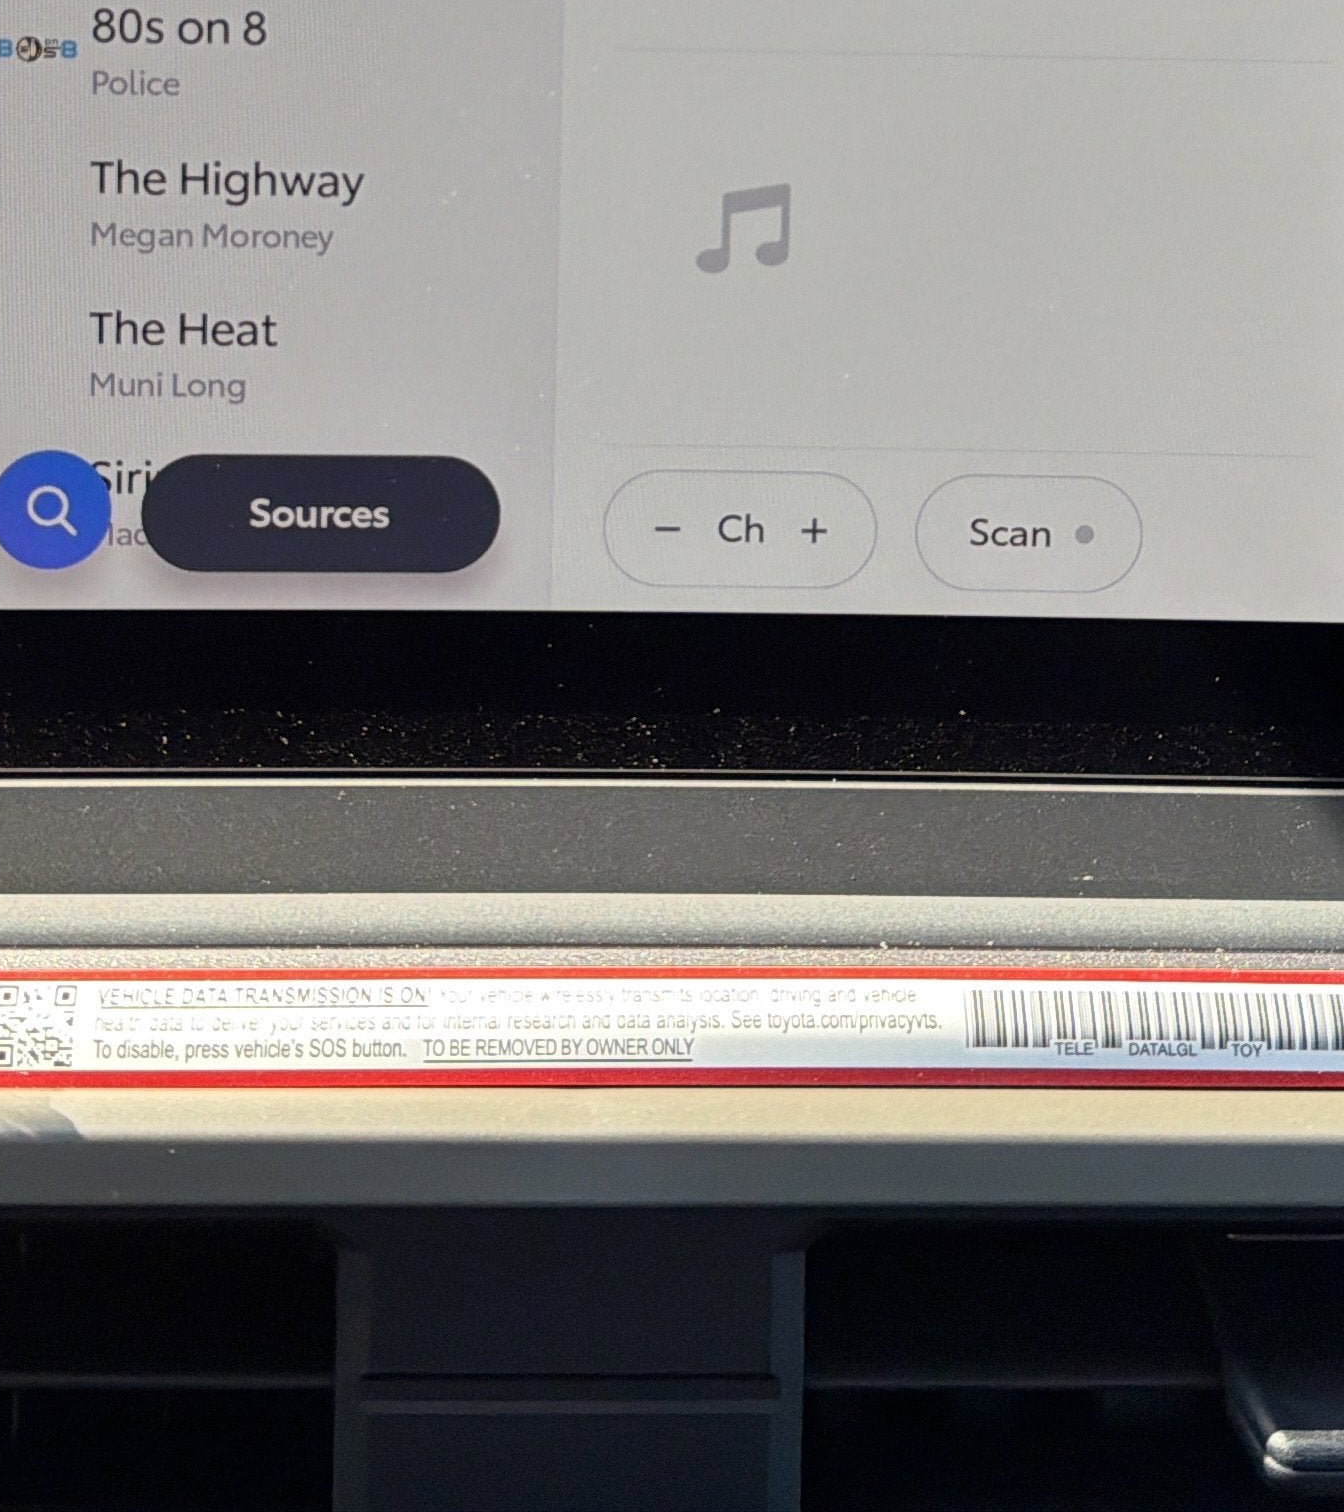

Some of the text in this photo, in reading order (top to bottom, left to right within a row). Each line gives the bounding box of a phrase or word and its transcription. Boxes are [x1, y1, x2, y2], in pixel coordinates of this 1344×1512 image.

[92, 8, 268, 46] 80s on 8
[92, 69, 181, 97] Police
[90, 159, 366, 207] The Highway
[91, 222, 334, 256] Megan Moroney
[89, 309, 279, 347] The Heat
[90, 372, 246, 405] Muni Long
[249, 497, 391, 529] Sources
[717, 513, 765, 544] Ch
[969, 518, 1051, 548] Scan
[98, 987, 175, 1006] VEHICLE
[181, 987, 228, 1005] DATA
[234, 986, 372, 1005] TRANSMISSION
[378, 986, 394, 1004] IS
[507, 1014, 577, 1030] research
[731, 1009, 762, 1029] See
[92, 1037, 696, 1064] To disable, press vehicle's SOS button. TO BE REMOVED BY OWNER ONLY
[1056, 1041, 1264, 1058] TELE DATALGL TOY
